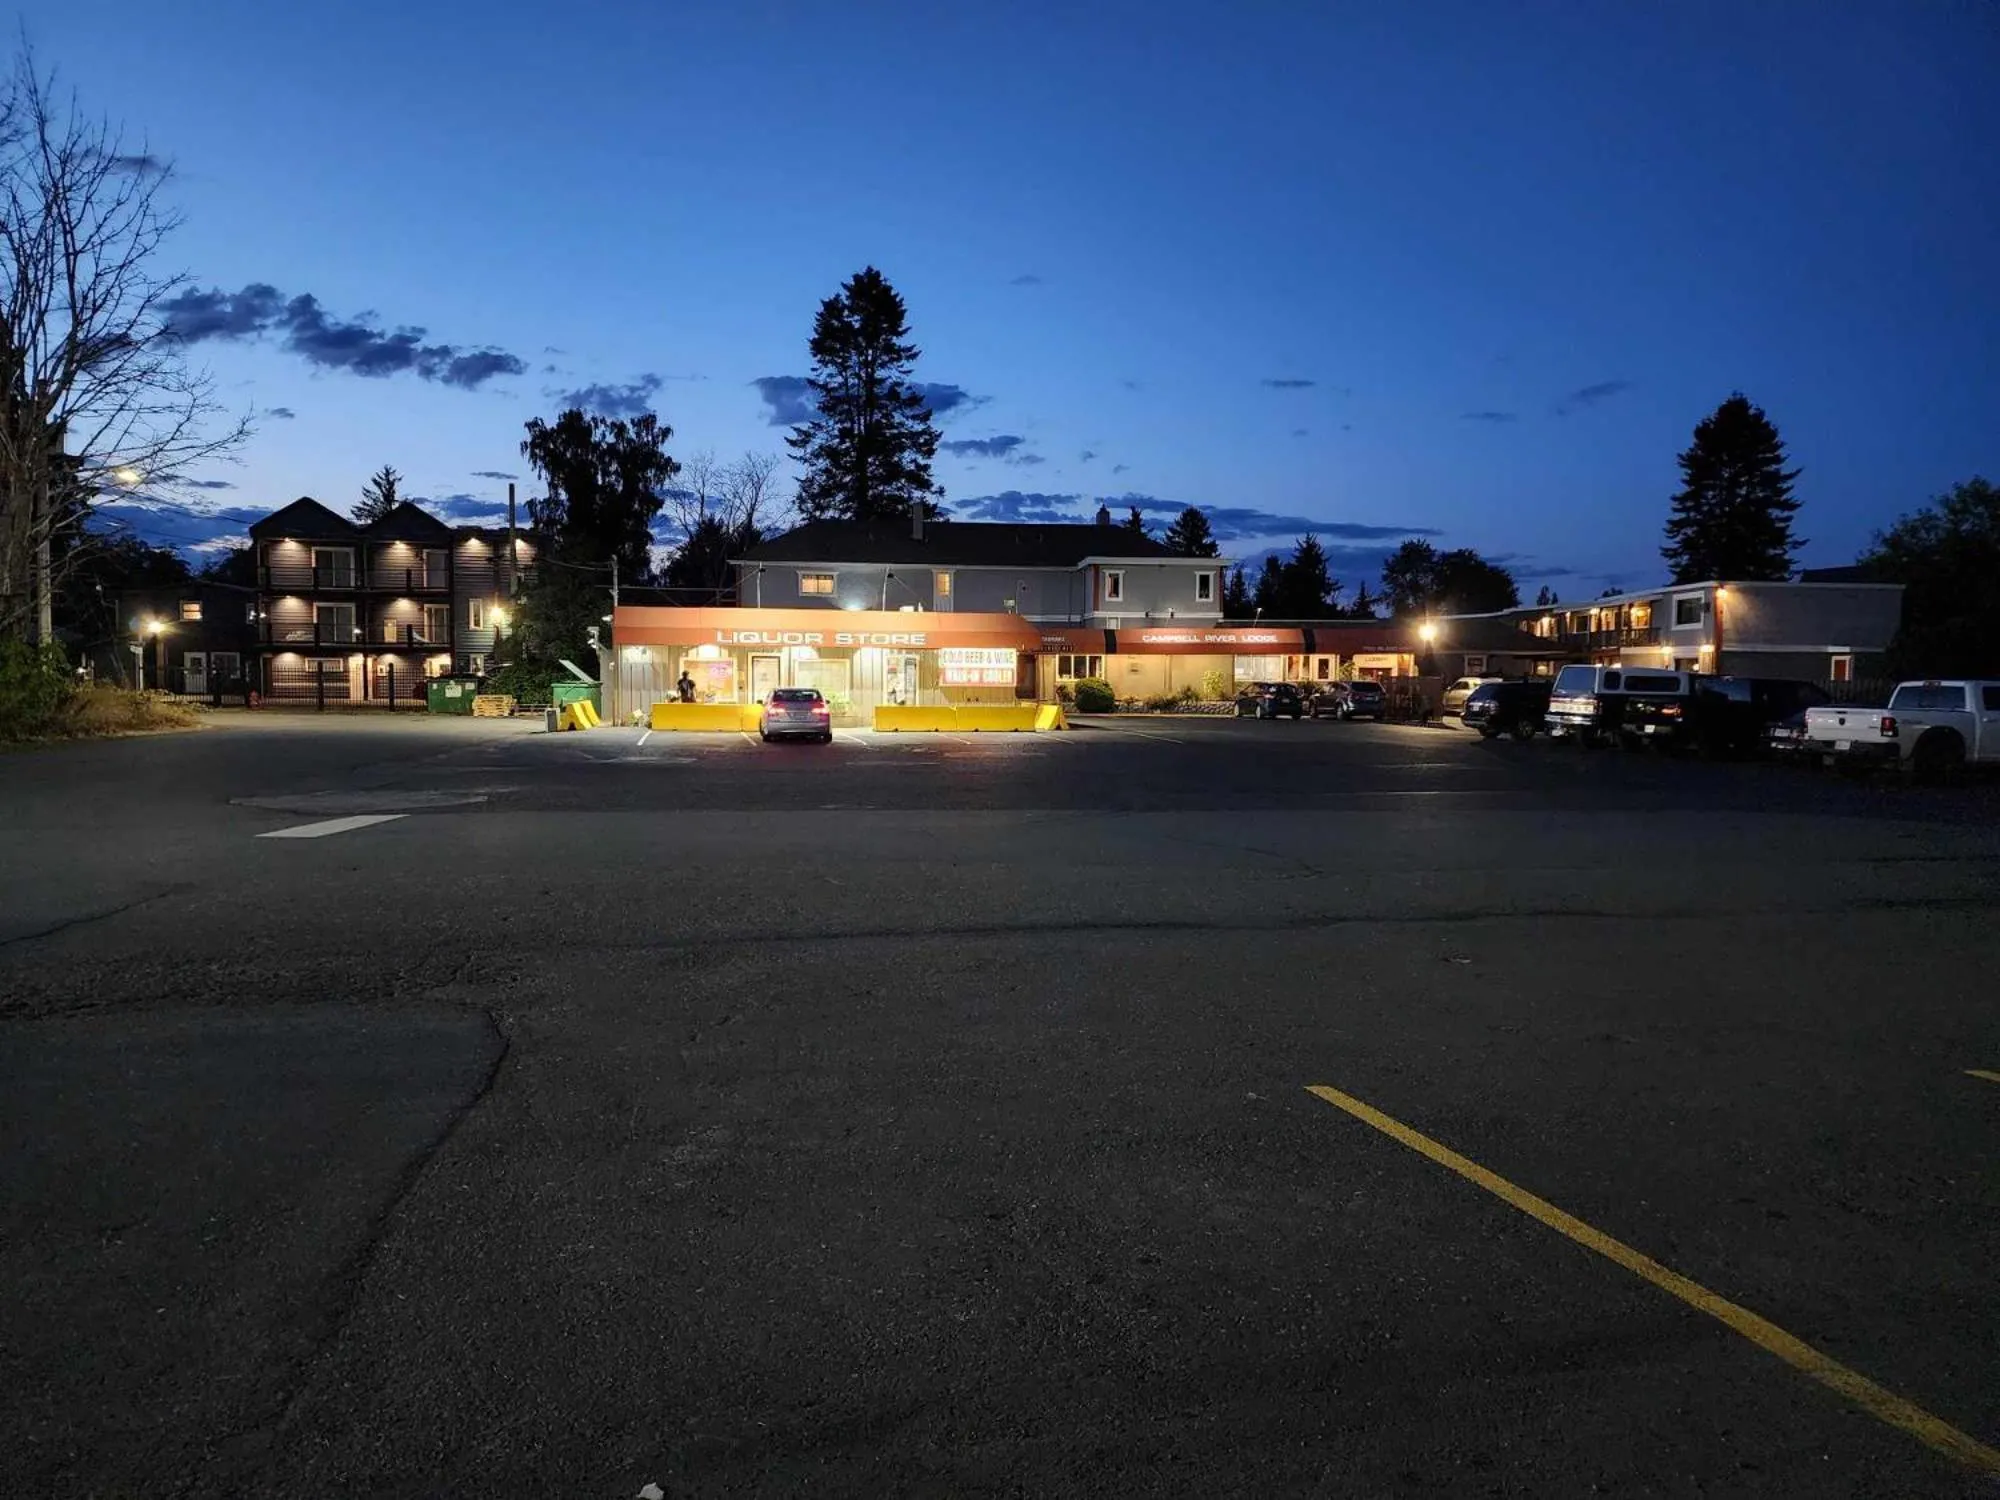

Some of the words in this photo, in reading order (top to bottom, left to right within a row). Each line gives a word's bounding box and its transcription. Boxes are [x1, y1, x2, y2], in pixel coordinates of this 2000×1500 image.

[716, 631, 823, 645] LIQUOR
[834, 632, 926, 646] STORE
[1142, 635, 1199, 643] CAMPBELL
[1204, 635, 1237, 643] RIVER
